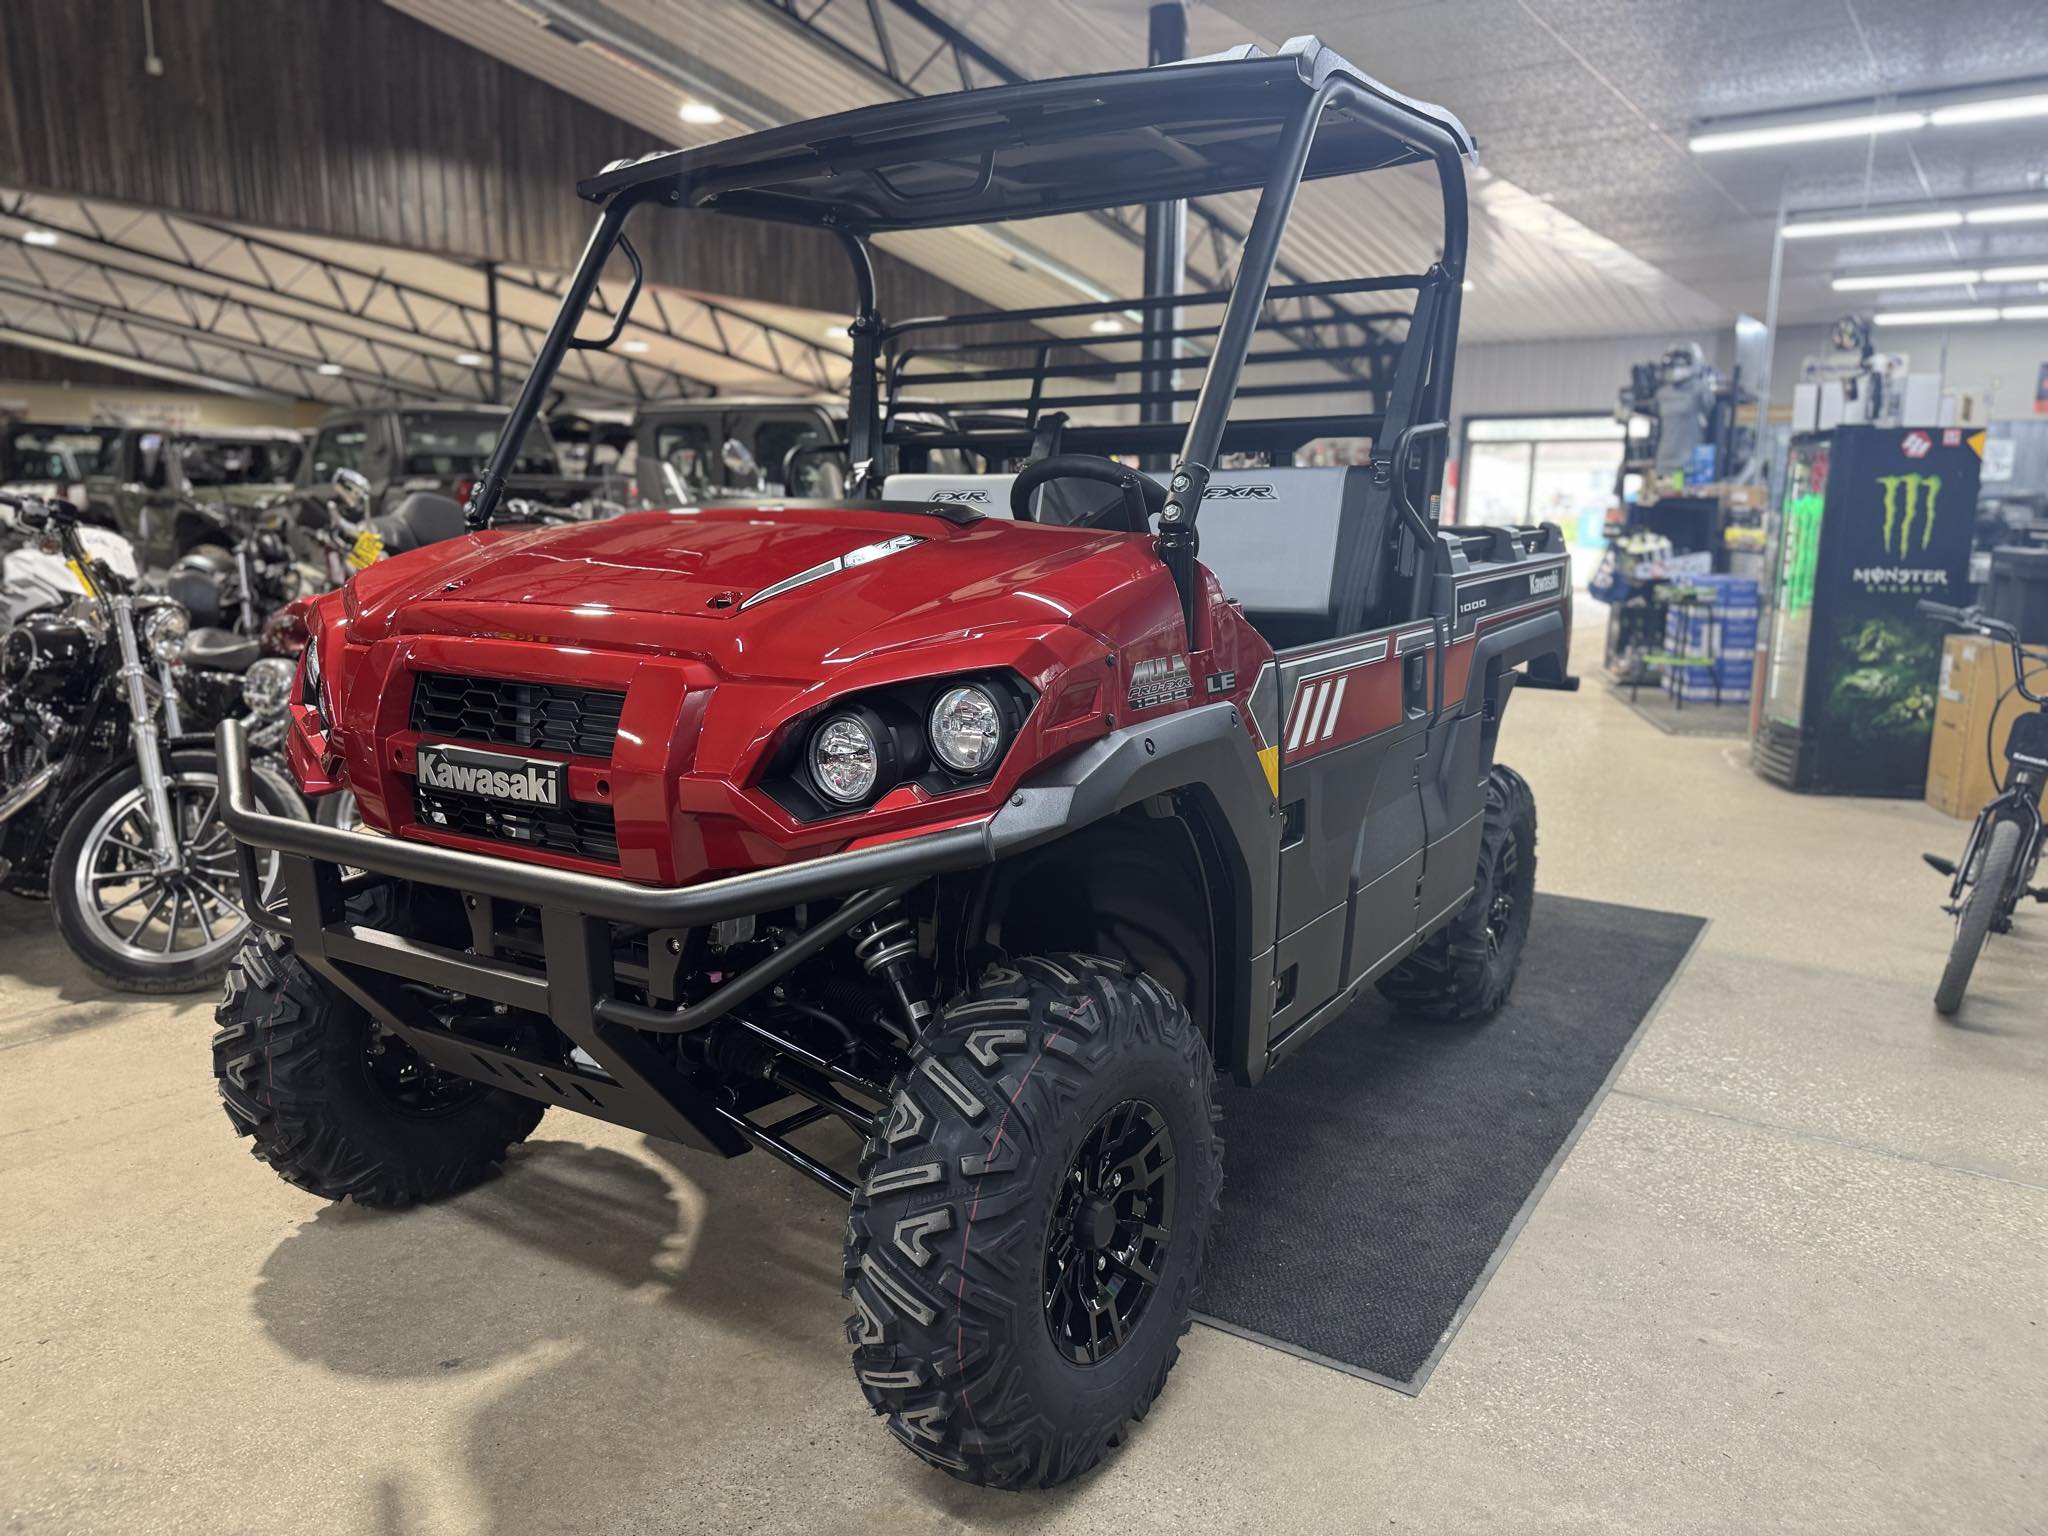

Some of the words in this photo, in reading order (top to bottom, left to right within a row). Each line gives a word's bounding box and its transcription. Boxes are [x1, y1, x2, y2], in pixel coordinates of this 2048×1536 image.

[929, 490, 991, 503] FXR
[1202, 485, 1278, 499] FXR
[1853, 567, 1948, 584] MONSTER
[1460, 599, 1487, 613] 1000
[1132, 654, 1190, 687] MULE
[1128, 676, 1193, 699] PRO-FXR
[1207, 673, 1235, 693] LE
[1137, 688, 1188, 707] 1000
[417, 751, 557, 804] Kawasaki
